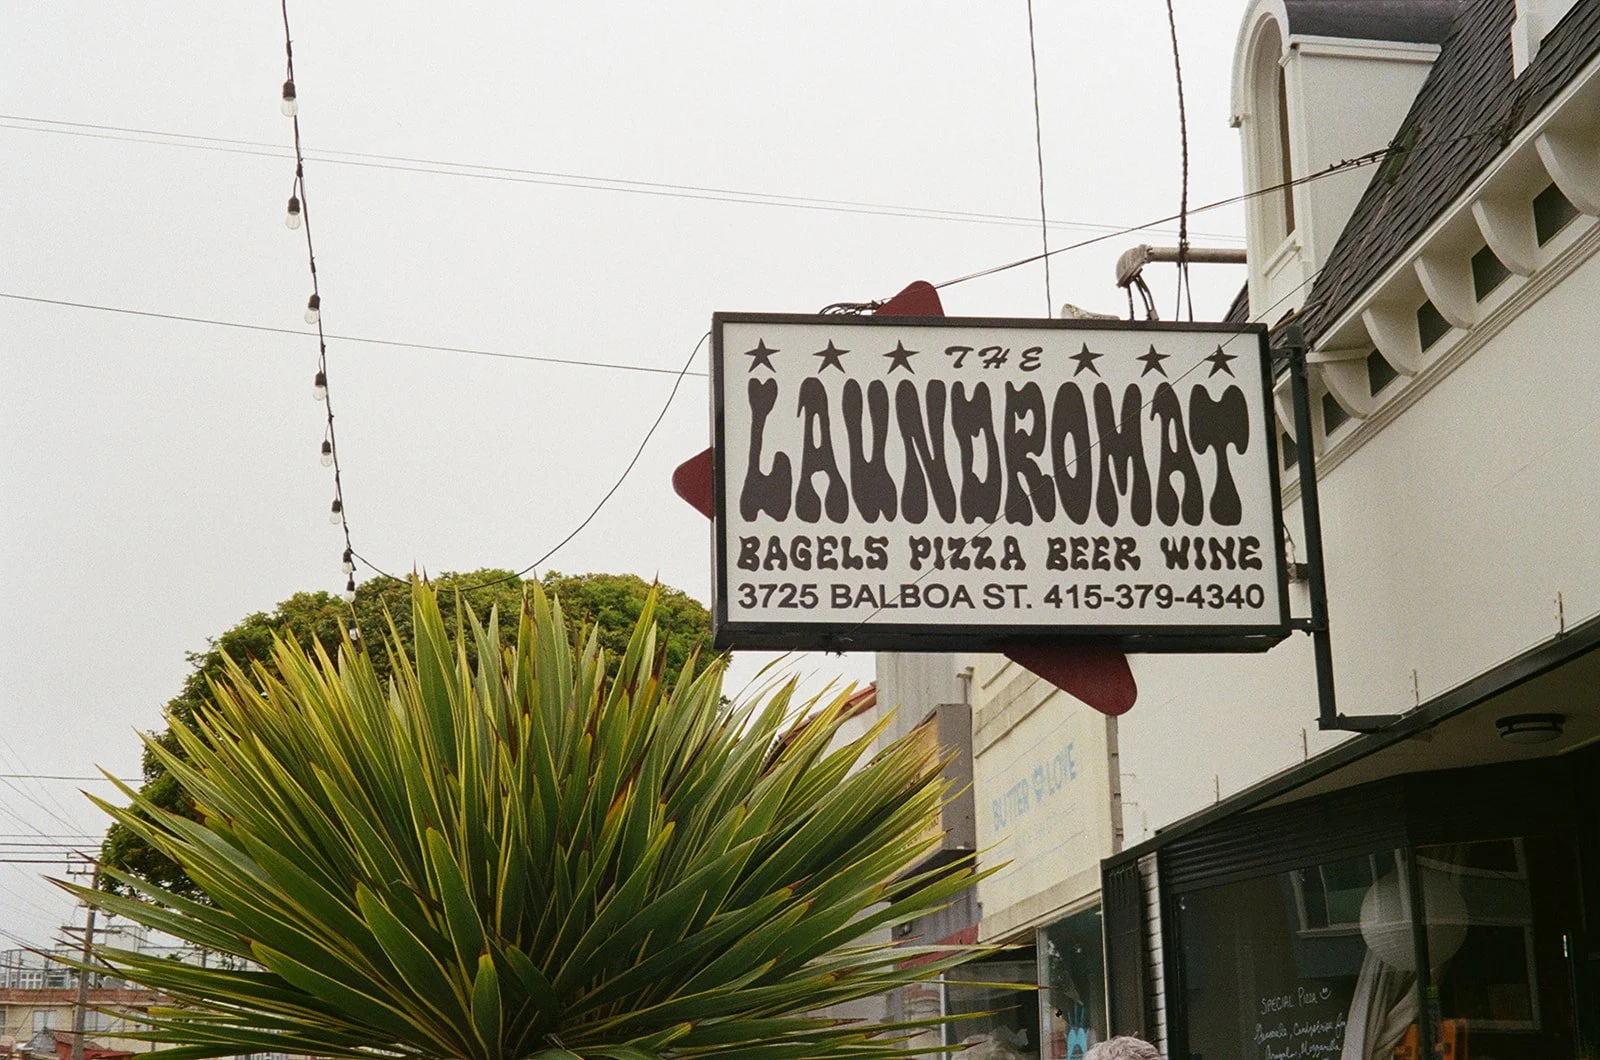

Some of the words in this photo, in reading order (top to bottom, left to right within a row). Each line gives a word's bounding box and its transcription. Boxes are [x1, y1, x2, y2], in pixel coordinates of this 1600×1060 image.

[945, 345, 1043, 372] THE
[740, 377, 1250, 527] LAUNDROMAT
[736, 535, 889, 571] BAGELS
[909, 535, 1027, 571] PIZZA
[1045, 536, 1142, 571] BEER
[1159, 536, 1263, 571] WINE
[738, 582, 819, 610] 3725
[830, 583, 976, 610] BALBOA
[982, 583, 1033, 610] ST.
[1043, 583, 1265, 610] 415-379-4340
[992, 779, 1029, 831] BUTTER
[1046, 742, 1077, 796] LOVE
